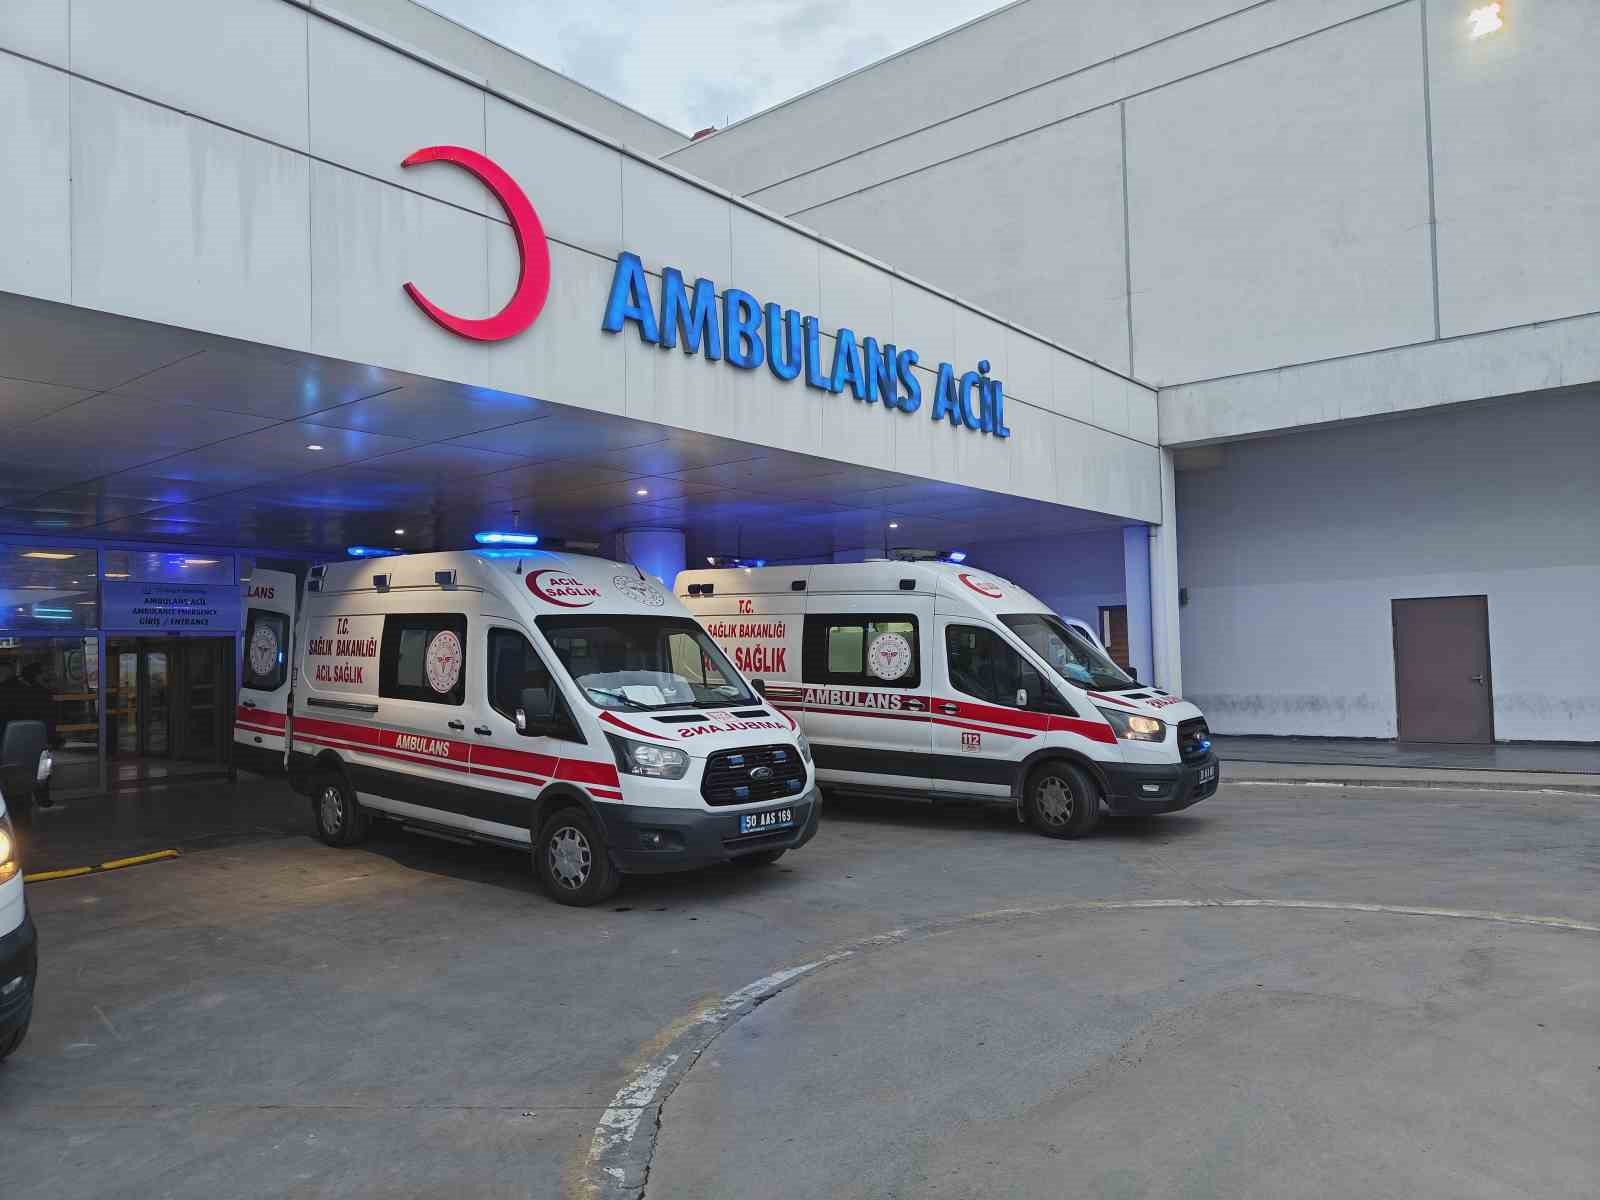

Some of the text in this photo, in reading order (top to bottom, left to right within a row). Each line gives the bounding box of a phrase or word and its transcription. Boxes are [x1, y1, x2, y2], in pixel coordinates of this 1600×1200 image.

[602, 250, 1010, 438] AMBULANS ACİL
[545, 586, 601, 597] SAĞLIK
[739, 600, 754, 613] T.C.
[337, 618, 349, 634] T.C.
[708, 621, 785, 638] SAĞLIK BAKANLIĞI
[309, 636, 377, 657] SAĞLIK BAKANLIĞI
[735, 644, 786, 672] SAĞLIK
[334, 661, 363, 683] SAĞLIK
[804, 688, 902, 710] AMBULANS
[395, 734, 450, 757] AMBULANS
[963, 734, 980, 744] 112
[746, 809, 791, 828] 50 AAS 169
